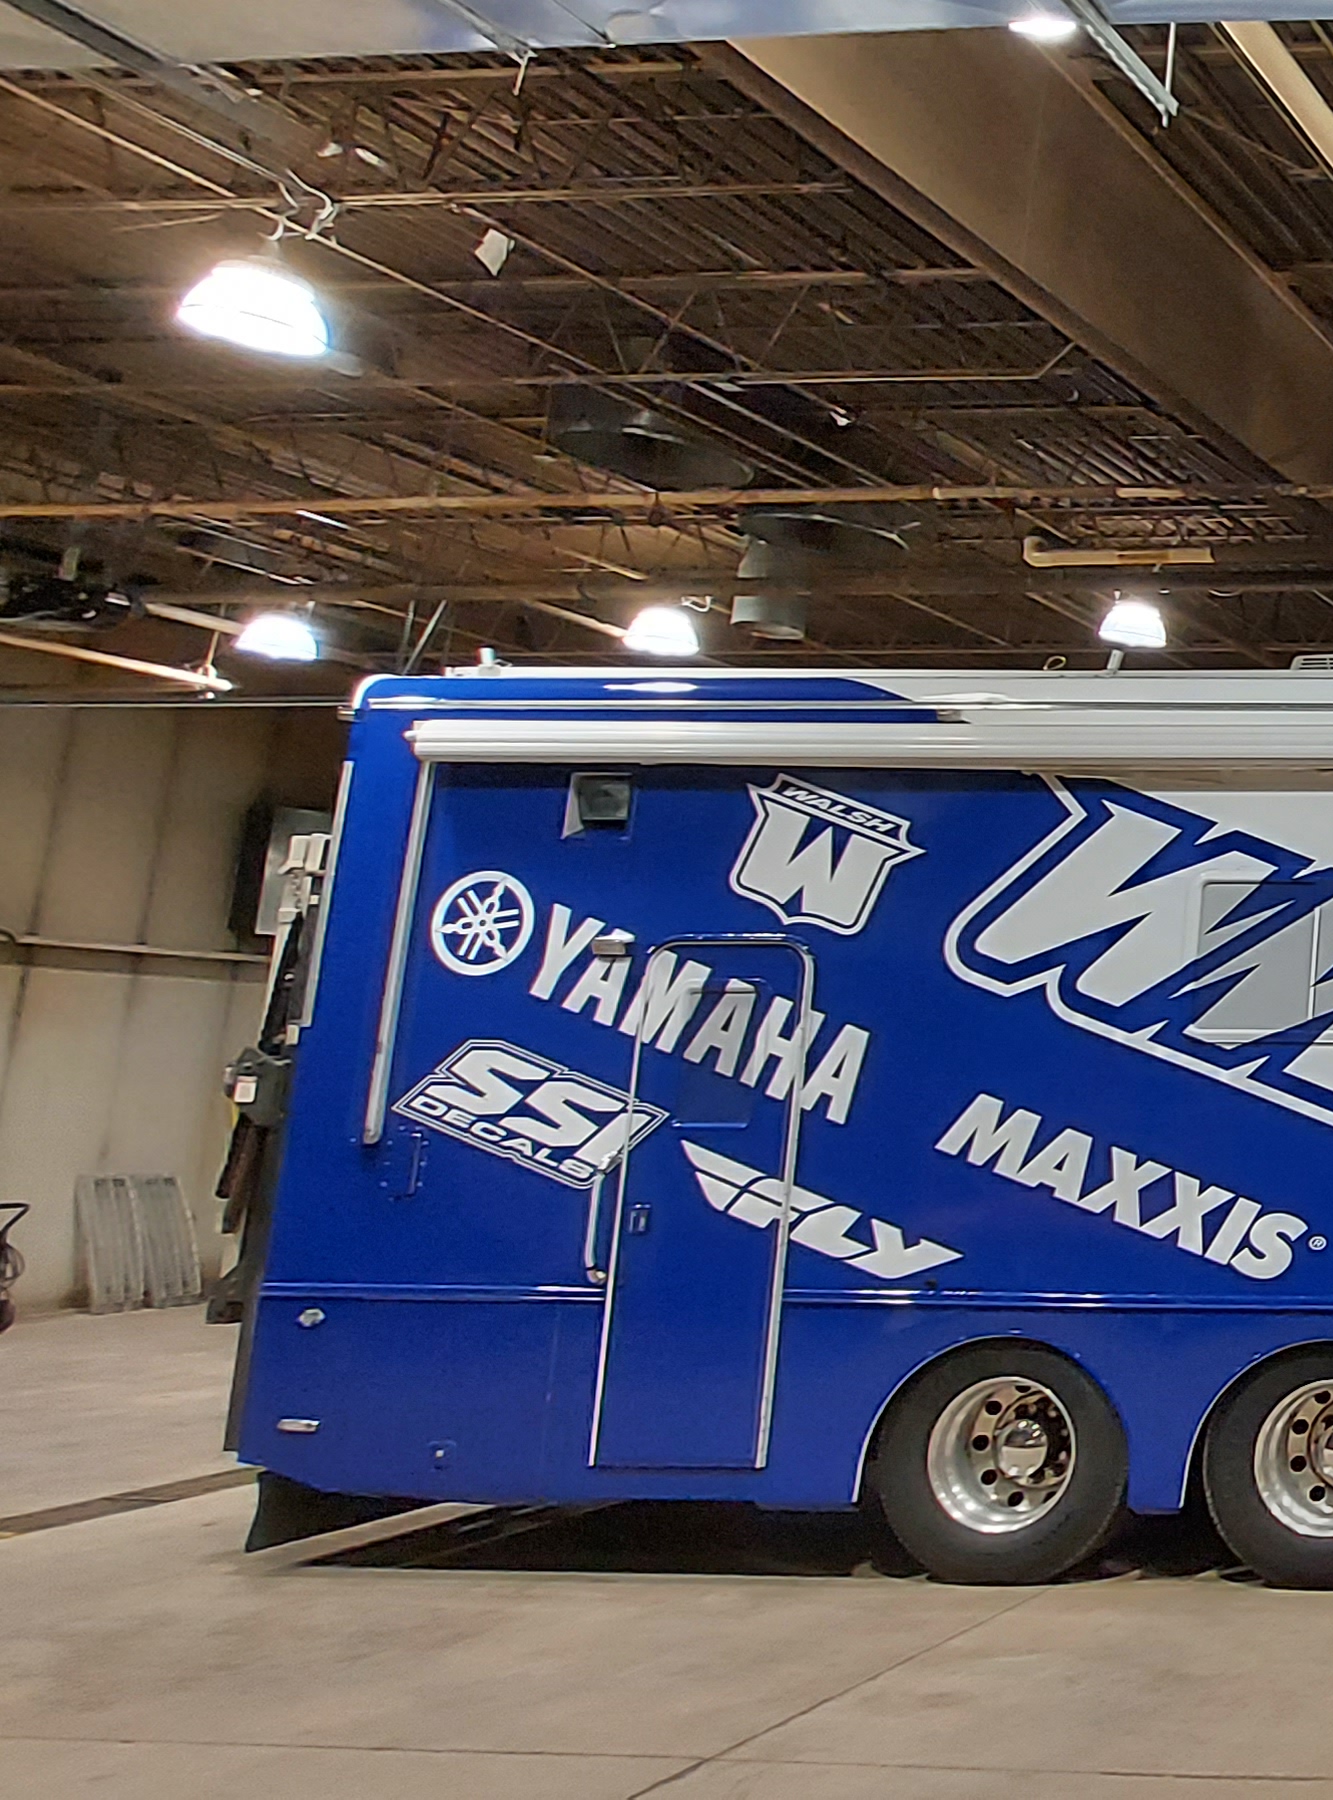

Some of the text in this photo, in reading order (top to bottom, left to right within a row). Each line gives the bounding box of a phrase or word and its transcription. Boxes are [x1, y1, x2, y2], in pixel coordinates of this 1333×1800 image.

[740, 799, 901, 925] W
[782, 786, 898, 832] WALSH
[529, 903, 870, 1125] YAMAHA
[407, 1092, 595, 1179] DECALS
[426, 1049, 650, 1166] SSI
